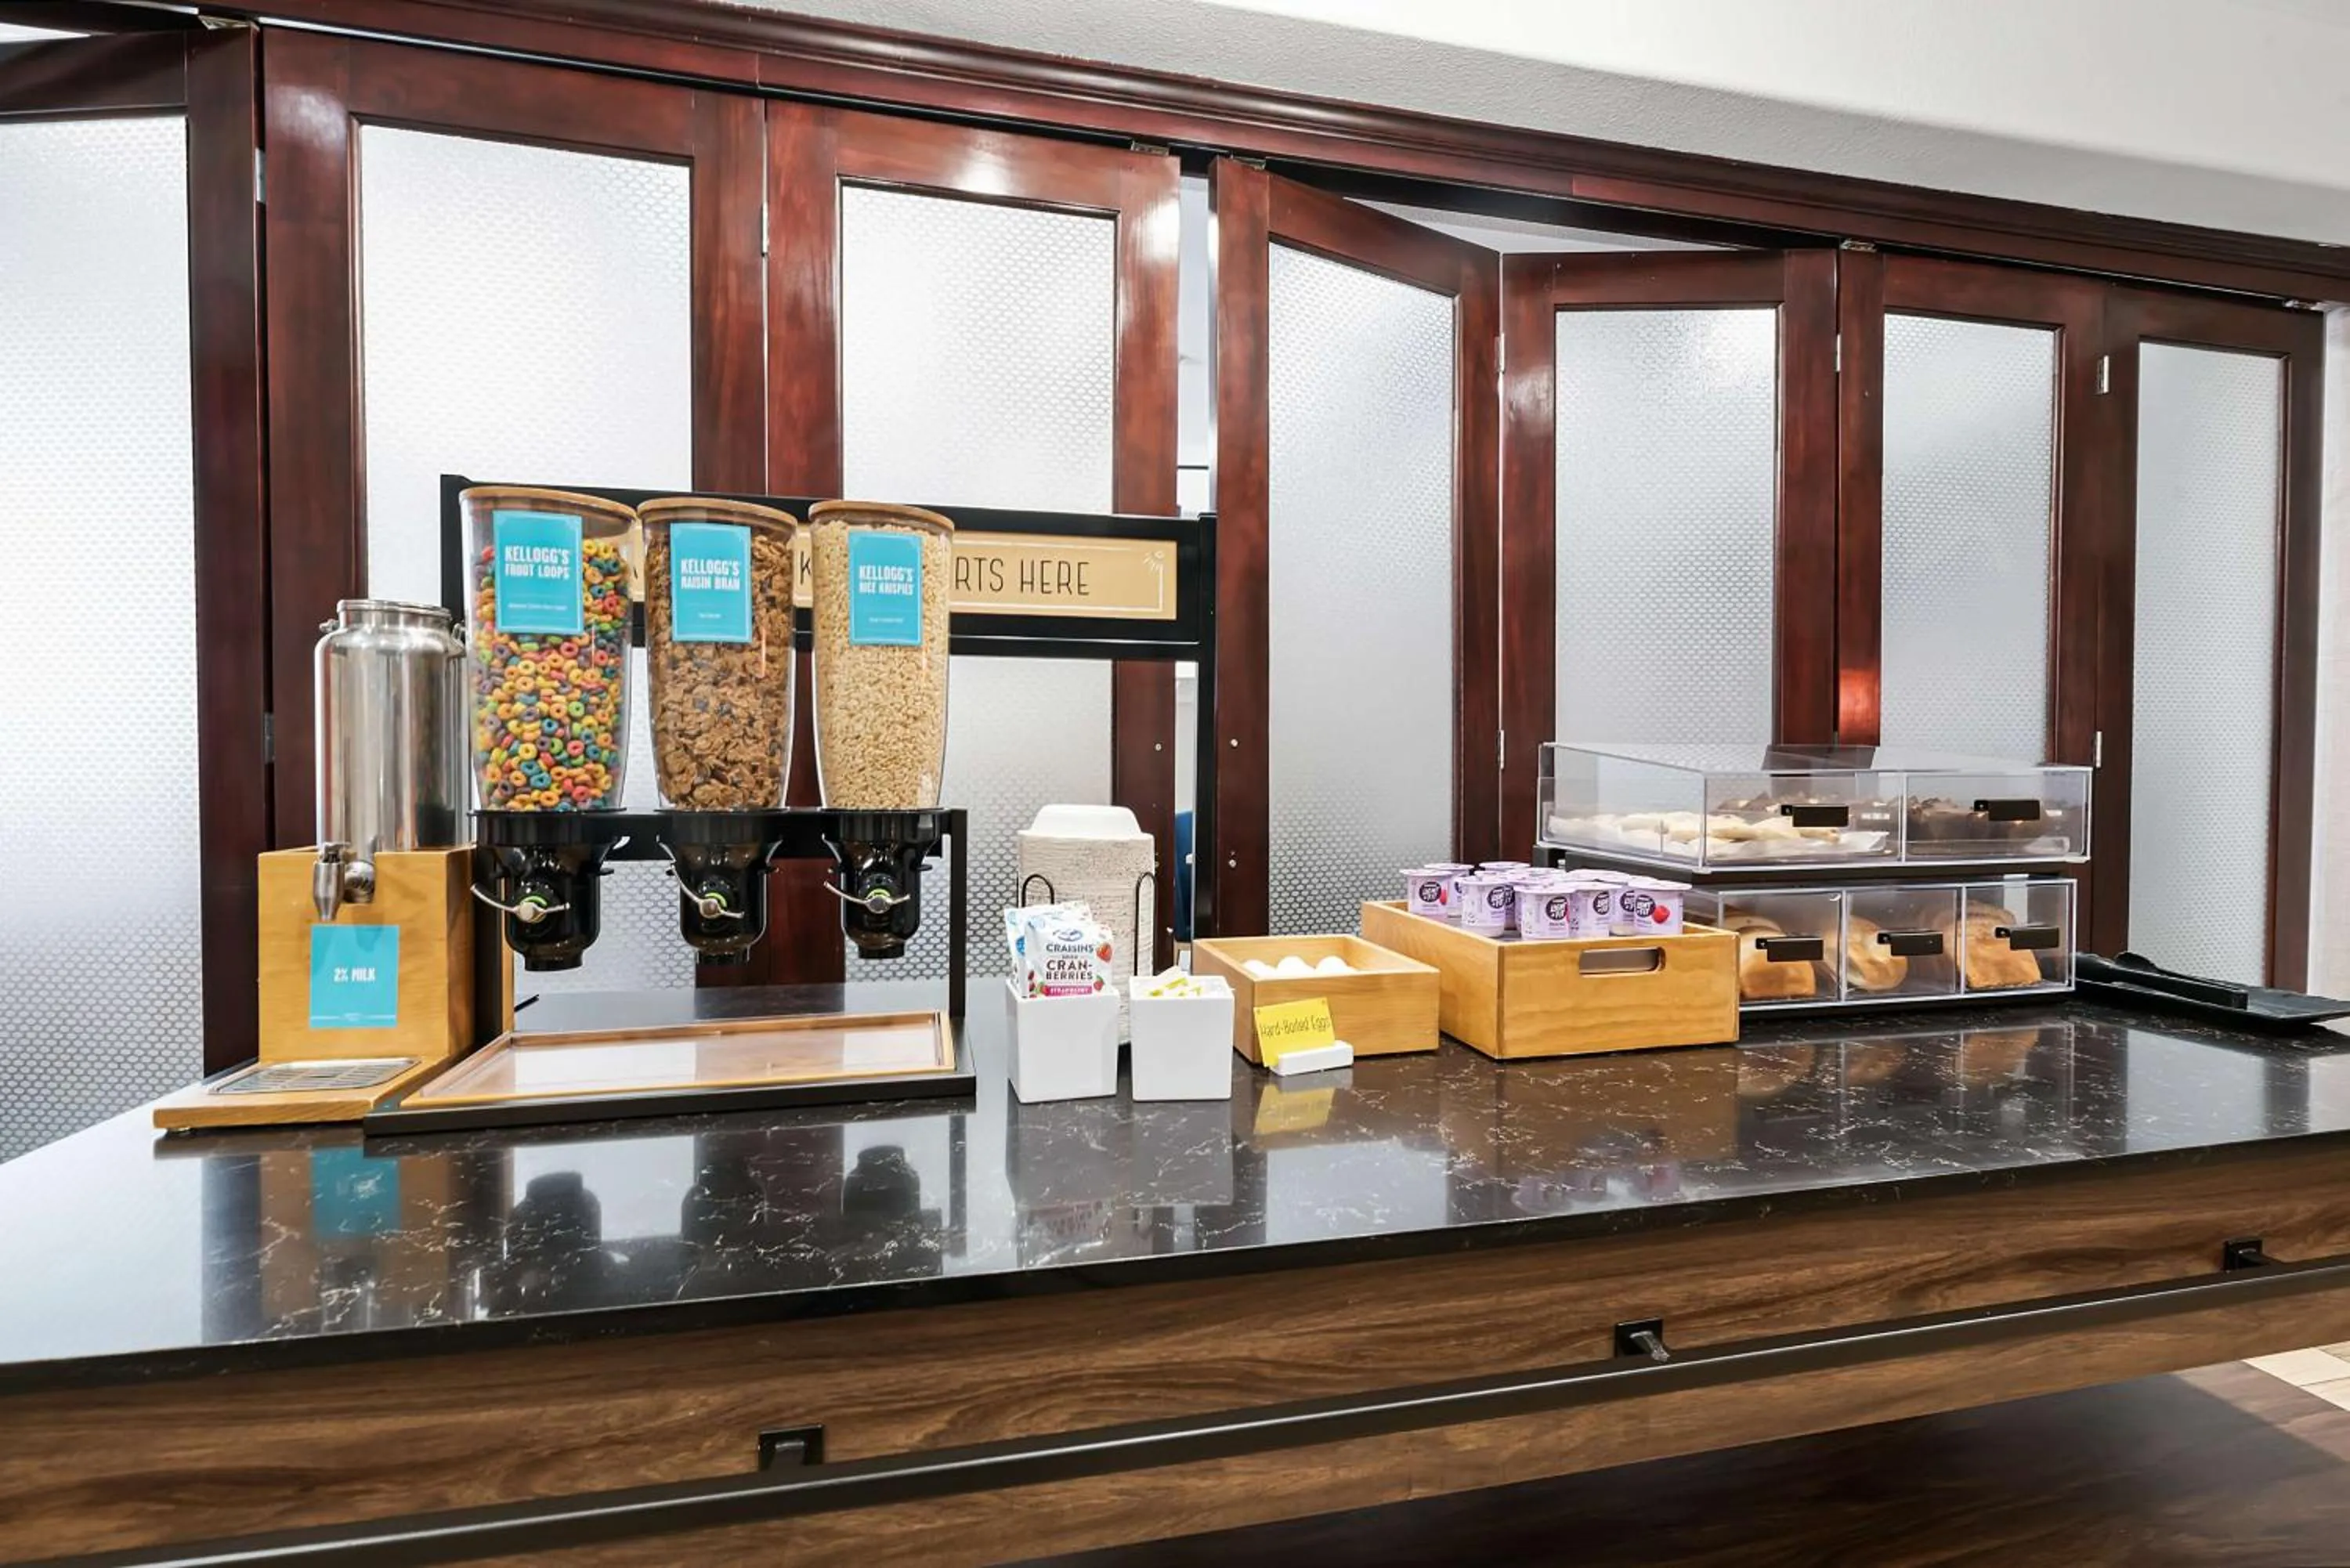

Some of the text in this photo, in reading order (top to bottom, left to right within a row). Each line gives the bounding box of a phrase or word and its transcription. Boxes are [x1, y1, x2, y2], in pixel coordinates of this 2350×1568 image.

[504, 544, 569, 564] KELLOGG'S
[538, 564, 570, 580] LOOPS
[681, 558, 740, 577] KELLOGG'S
[859, 565, 913, 583] KELLOGG'S
[955, 556, 1090, 596] RTS HERE
[1046, 944, 1094, 953] CRAISINS
[1046, 959, 1094, 970] CRAN-
[333, 966, 376, 983] 2% MILK
[1046, 971, 1093, 980] BERRIES
